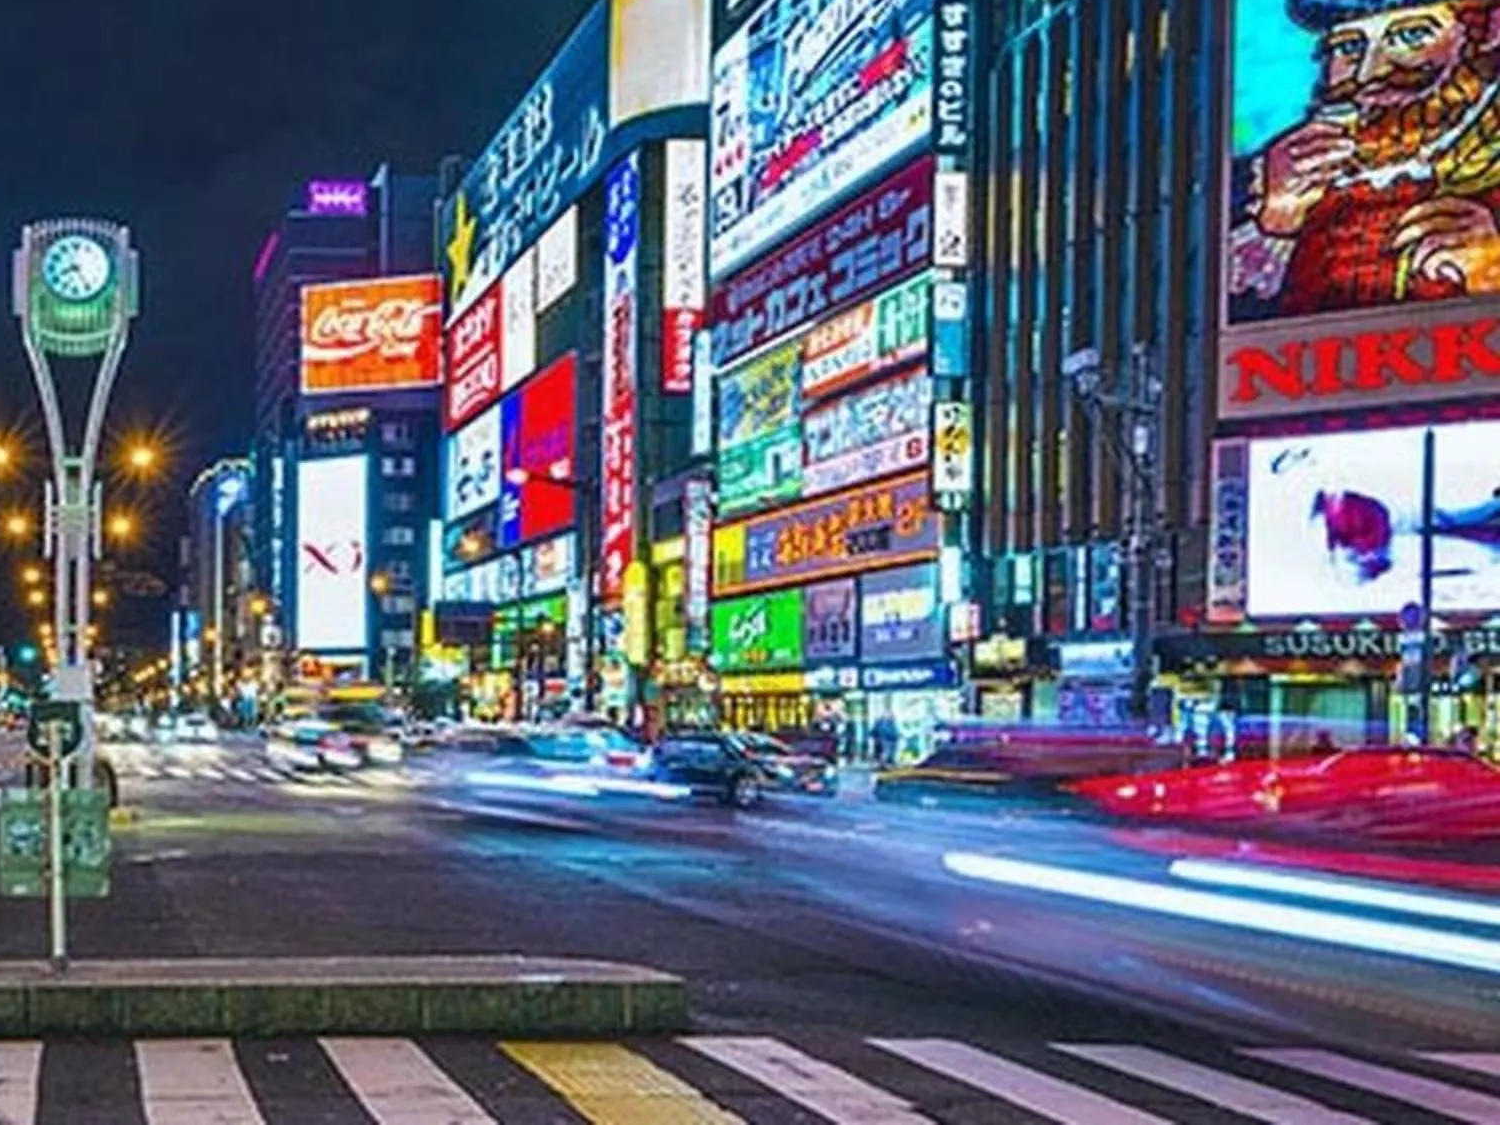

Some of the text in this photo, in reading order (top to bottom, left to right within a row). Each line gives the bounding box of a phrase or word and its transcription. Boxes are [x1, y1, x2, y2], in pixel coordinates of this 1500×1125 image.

[831, 205, 930, 300] コミック
[1226, 317, 1500, 405] NIKK
[1264, 630, 1447, 655] SUSUKI
